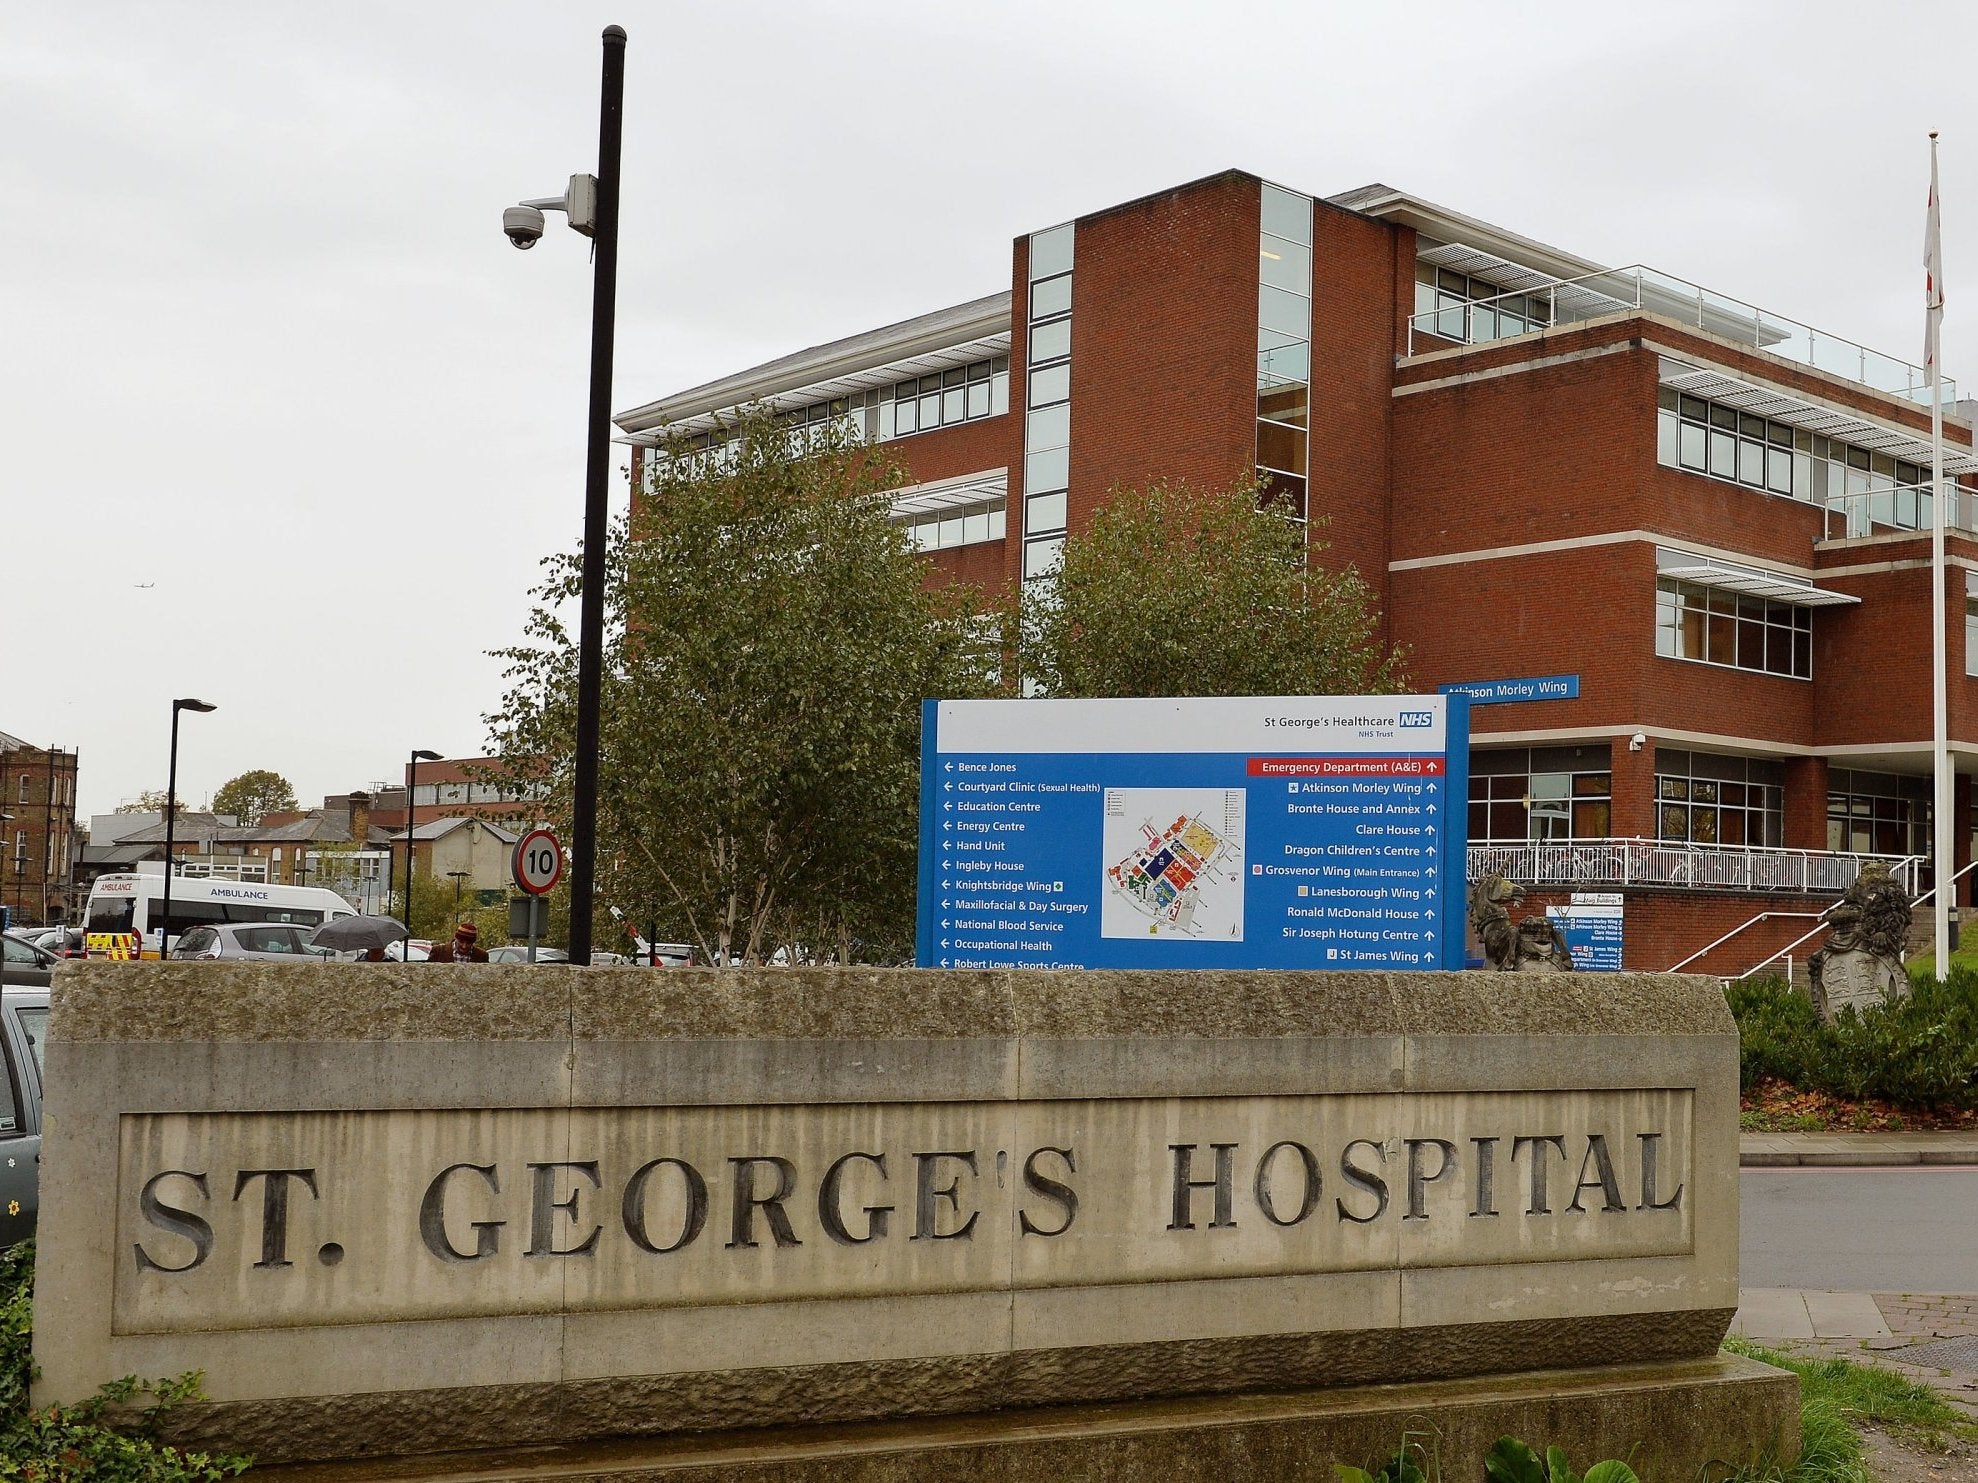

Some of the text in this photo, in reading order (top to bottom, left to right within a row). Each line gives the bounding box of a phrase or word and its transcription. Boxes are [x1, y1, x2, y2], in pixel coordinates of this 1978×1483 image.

[1450, 681, 1567, 697] nson Morley Wing
[1264, 717, 1394, 728] St George's Healthcare
[1401, 713, 1431, 726] NHS
[959, 763, 1016, 772] Bence Jones
[1263, 762, 1421, 774] Emergency Department (A&E)
[958, 782, 1100, 793] Courtyard Clinic (Sexual Health)
[1302, 783, 1421, 794] Atkinson Morley Wing
[958, 802, 1040, 812] Education Centre
[1288, 804, 1420, 814] Bronte House and Annex
[957, 822, 1025, 833] Energy Centre
[1356, 825, 1420, 835] Clare House
[956, 841, 1005, 851] Hand Unit
[1285, 845, 1420, 857] Dragon Children's Centre
[529, 850, 553, 874] 10
[956, 861, 1024, 872] Ingleby House
[1266, 866, 1420, 878] Grosvenor Wing (Main Entrance)
[100, 883, 132, 891] AMBULANCE
[956, 881, 1051, 892] Knightsbridge Wing
[211, 889, 268, 899] AMBULANCE
[1312, 887, 1420, 899] Lanesborough Wing
[955, 900, 1088, 914] Maxillofacial & Day Surgery
[1288, 907, 1418, 919] Ronald McDonald House
[955, 920, 1063, 931] National Blood Service
[1283, 928, 1418, 941] Sir Joseph Hotung Centre
[955, 939, 1052, 951] Occupational Health
[1340, 950, 1351, 960] St
[1355, 951, 1389, 961] James
[1393, 951, 1418, 963] Wing
[954, 959, 1084, 970] Robert Lowe Sports Centre
[134, 1133, 1685, 1273] ST. GEORGE'S HOSPITAL
